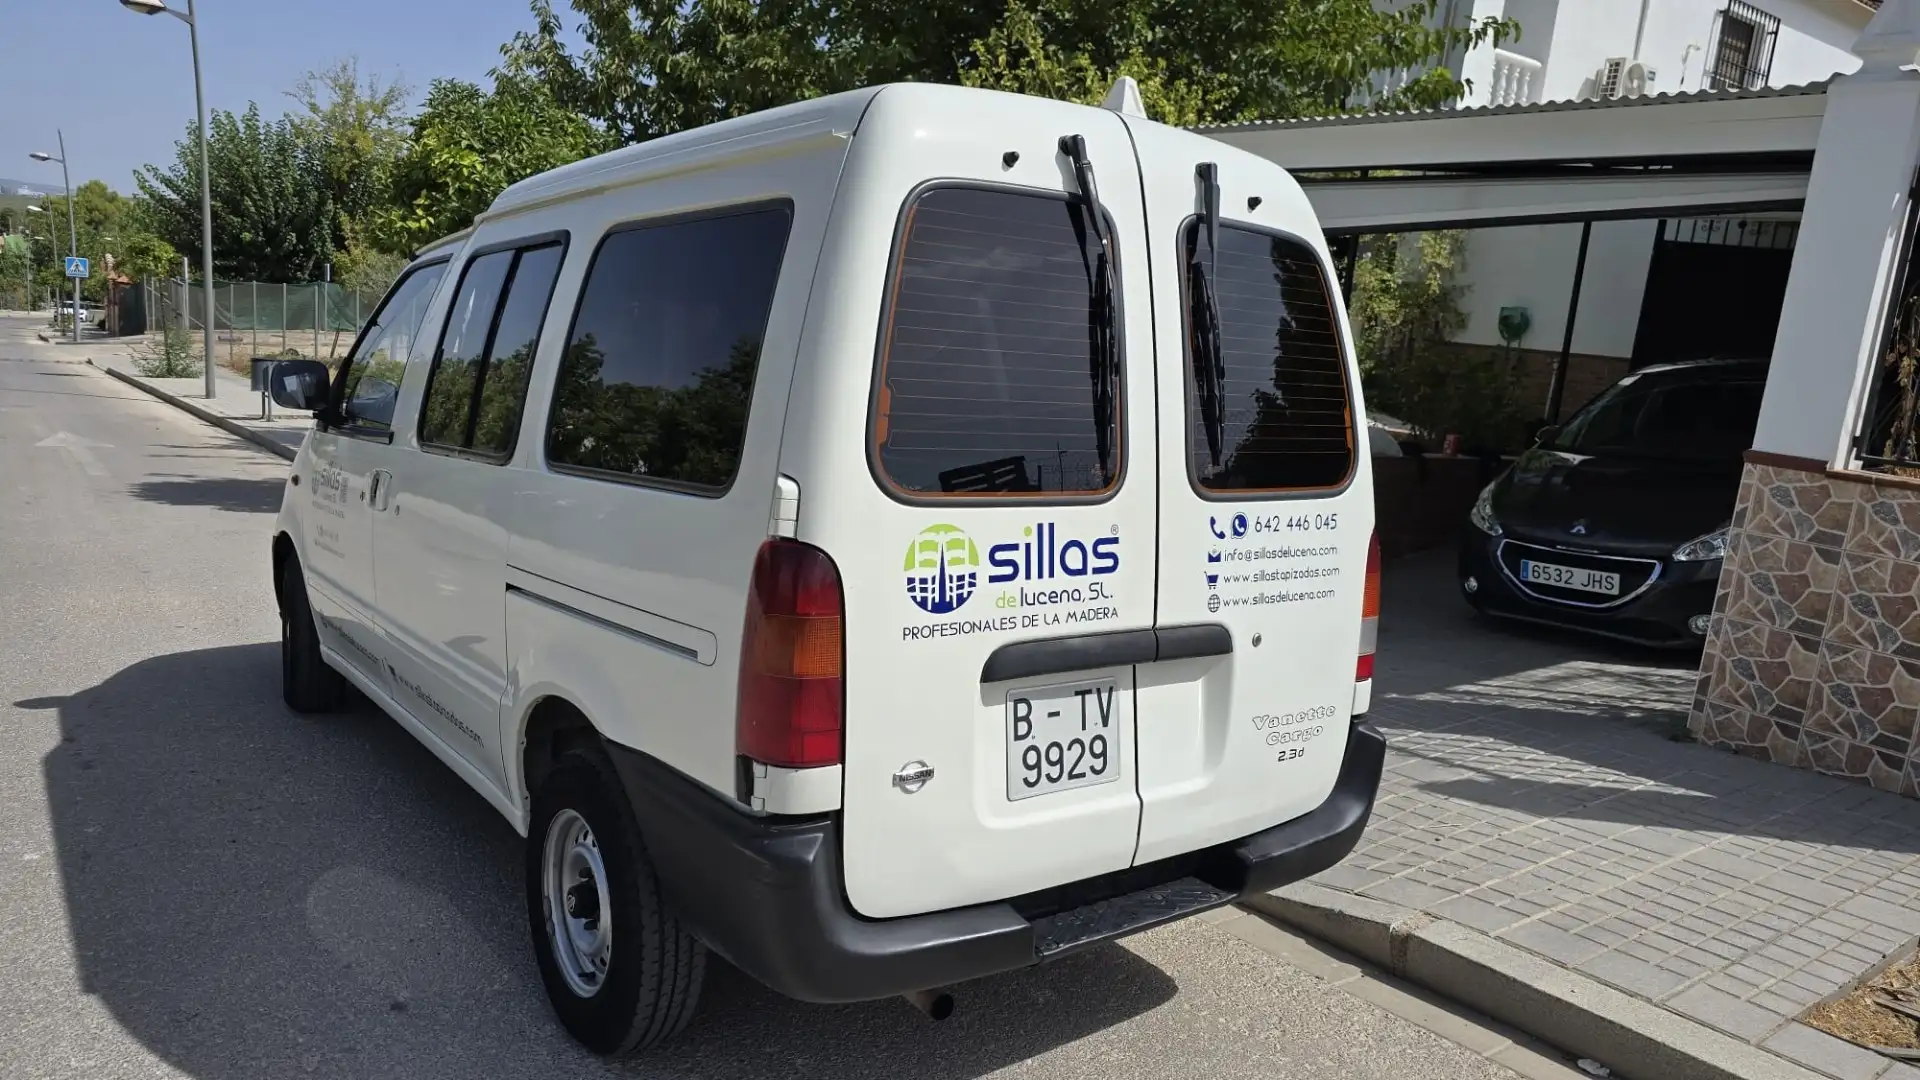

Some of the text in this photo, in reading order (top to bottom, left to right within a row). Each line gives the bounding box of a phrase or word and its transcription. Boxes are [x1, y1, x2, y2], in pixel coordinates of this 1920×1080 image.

[1255, 513, 1338, 533] 642 446 045
[988, 522, 1120, 583] sillas
[1224, 546, 1338, 562] info@sillasdelucena.com
[1223, 567, 1340, 584] www.sillastapizadas.com
[1531, 564, 1615, 591] 6532 JHS
[996, 591, 1017, 609] de
[1020, 585, 1087, 607] lucena,
[1223, 588, 1336, 607] www.sillasdelucena.com
[902, 606, 1119, 641] PROFESIONALES DE LA MADERA
[1013, 697, 1033, 742] B
[1074, 685, 1114, 731] TV
[1252, 705, 1336, 731] Vanette
[1266, 725, 1323, 746] Cargo
[1022, 733, 1108, 788] 9929
[1277, 747, 1305, 762] 2.3d
[899, 768, 934, 783] NISSAN
